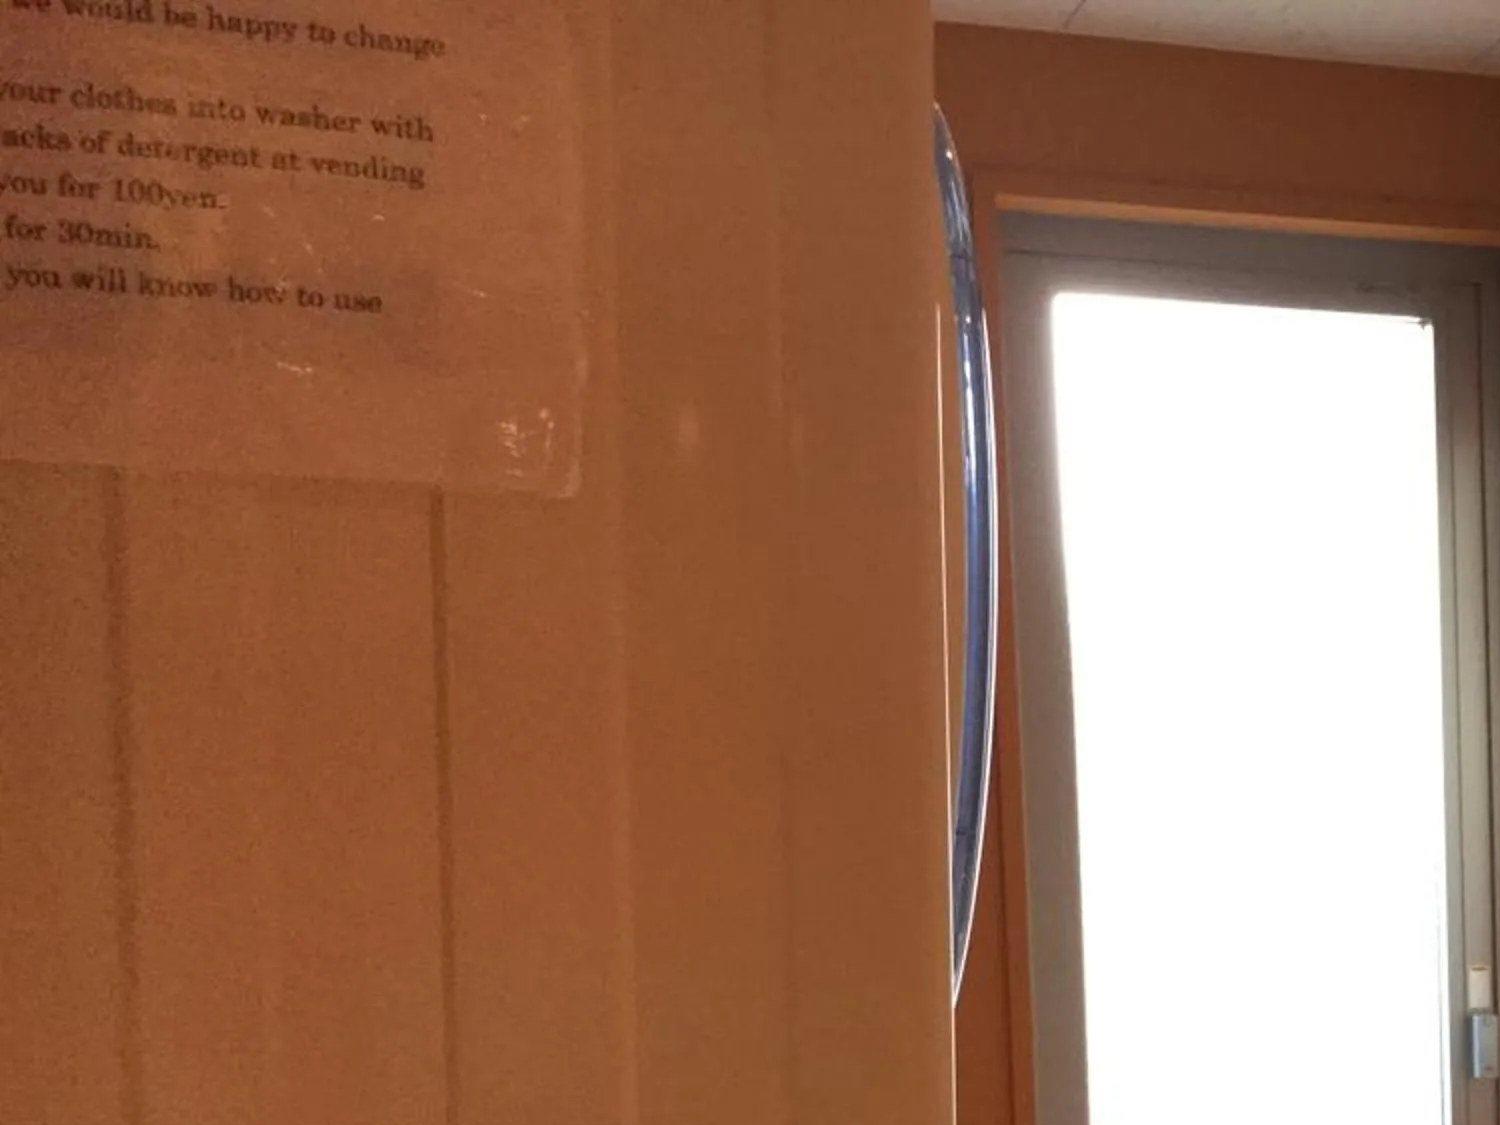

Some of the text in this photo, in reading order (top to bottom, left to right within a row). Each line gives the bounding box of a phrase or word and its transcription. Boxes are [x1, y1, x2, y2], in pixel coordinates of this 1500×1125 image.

[62, 0, 154, 23] would
[163, 0, 198, 28] be
[205, 3, 297, 43] happy
[307, 21, 336, 44] to
[344, 23, 445, 60] change
[69, 81, 177, 116] clothes
[187, 92, 245, 121] into
[256, 104, 361, 133] washer
[371, 114, 433, 142] with
[79, 129, 113, 153] of
[118, 132, 262, 170] detergent
[272, 149, 301, 171] at
[309, 156, 425, 190] vending
[58, 171, 100, 199] for
[115, 177, 228, 211] 100yen.
[5, 213, 161, 252] for 30min.
[5, 265, 382, 313] you will know how to use
